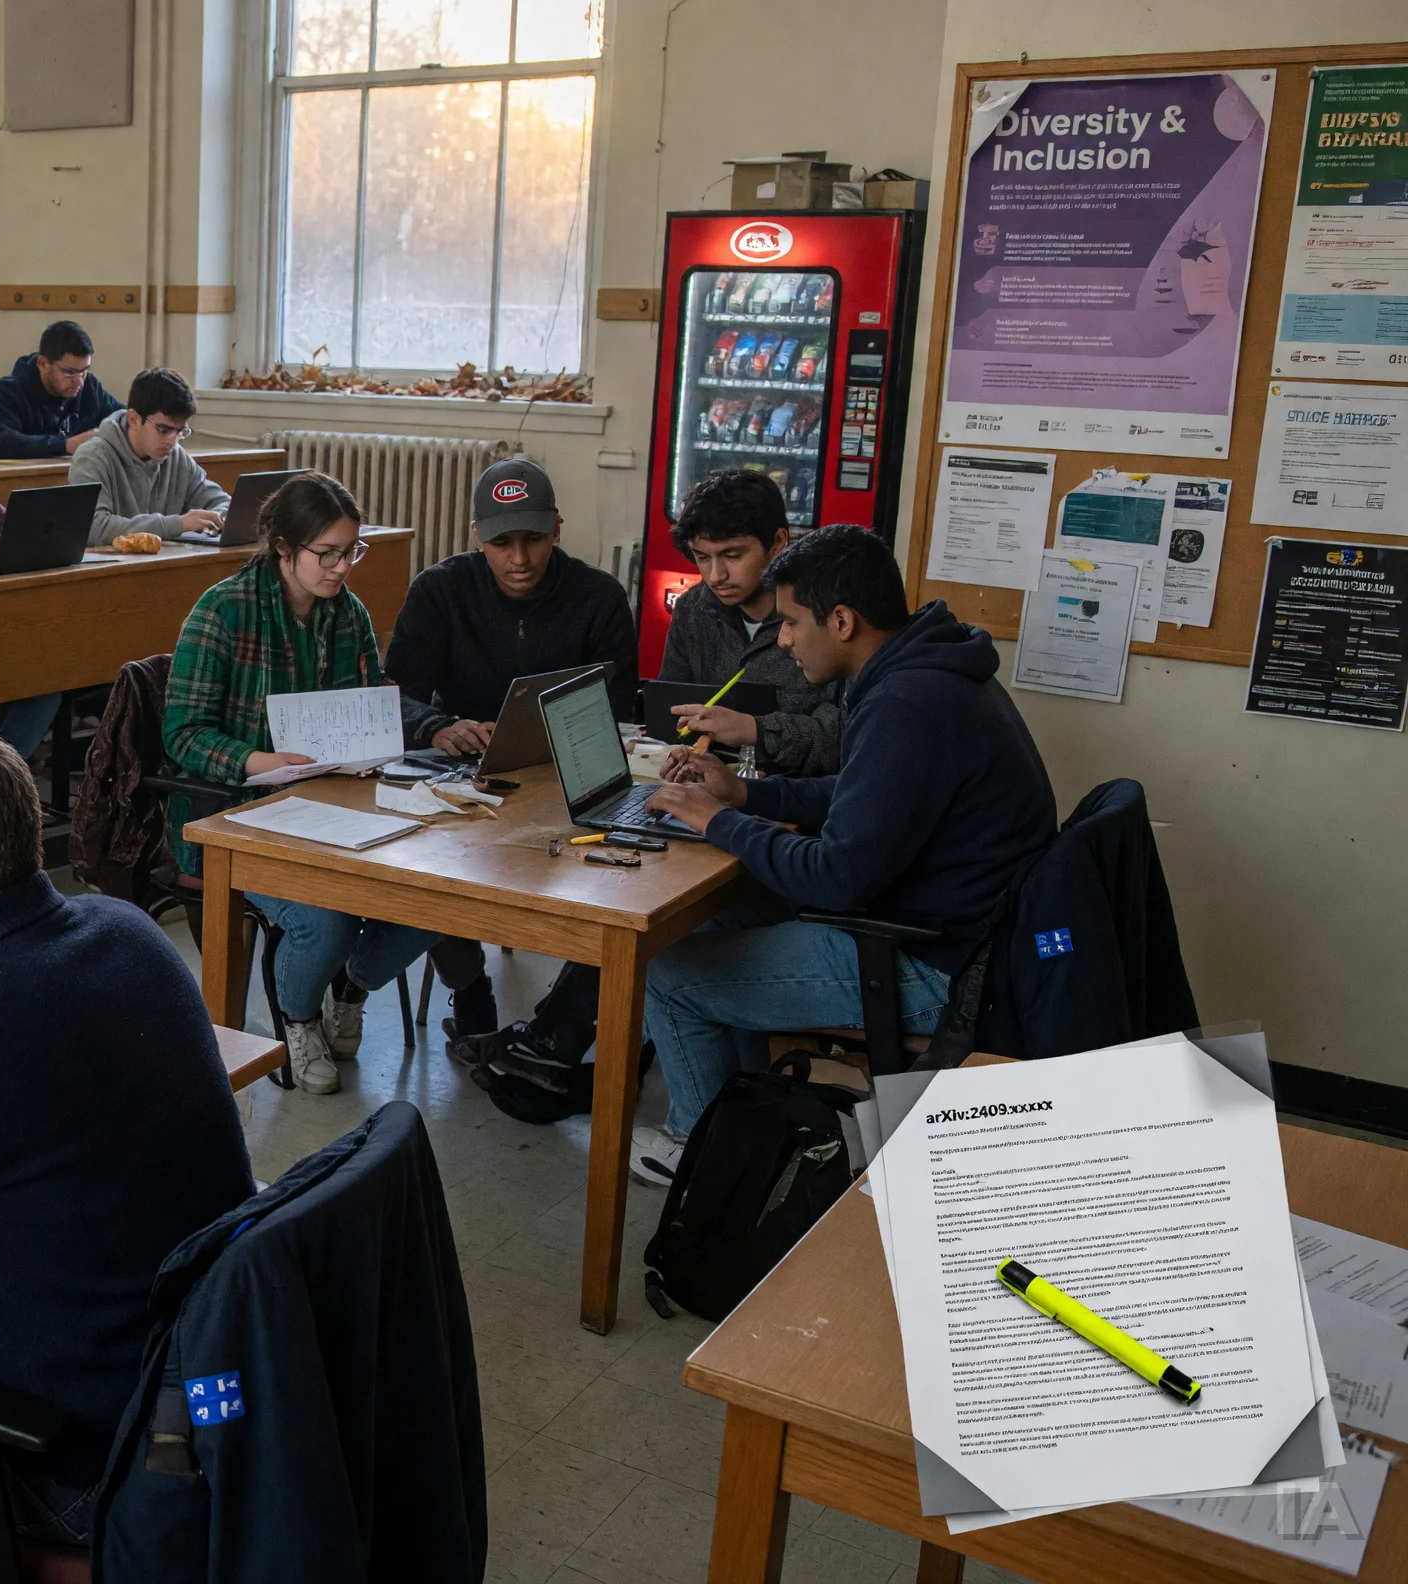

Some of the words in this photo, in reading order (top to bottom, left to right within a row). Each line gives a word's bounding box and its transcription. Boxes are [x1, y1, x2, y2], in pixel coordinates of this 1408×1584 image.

[994, 105, 1152, 142] Diversity
[1159, 104, 1186, 133] &
[992, 141, 1151, 171] Inclusion
